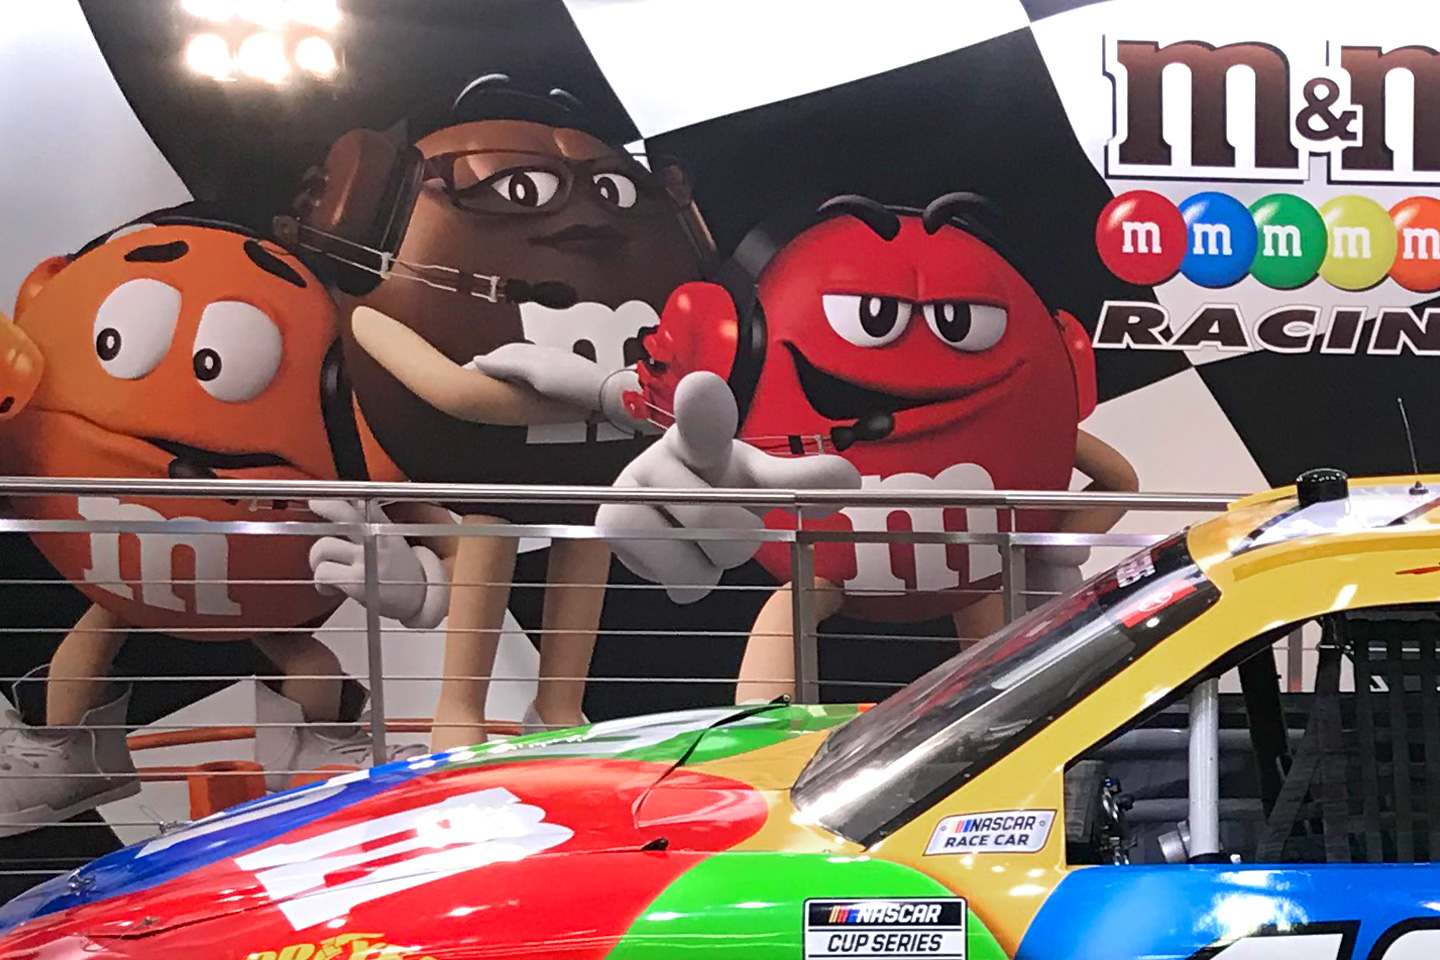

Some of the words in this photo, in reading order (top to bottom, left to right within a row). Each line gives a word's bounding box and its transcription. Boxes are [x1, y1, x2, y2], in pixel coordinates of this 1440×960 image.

[1121, 219, 1163, 255] m
[1192, 222, 1233, 256] m
[1262, 223, 1303, 257] m
[1332, 224, 1373, 259] m
[843, 462, 1004, 596] m
[76, 496, 242, 616] m
[970, 815, 1037, 833] NASCAR
[943, 834, 989, 849] RACE
[993, 833, 1030, 847] CAR
[854, 903, 943, 924] NASCAR
[826, 933, 870, 952] CUP
[870, 932, 943, 952] SERIES
